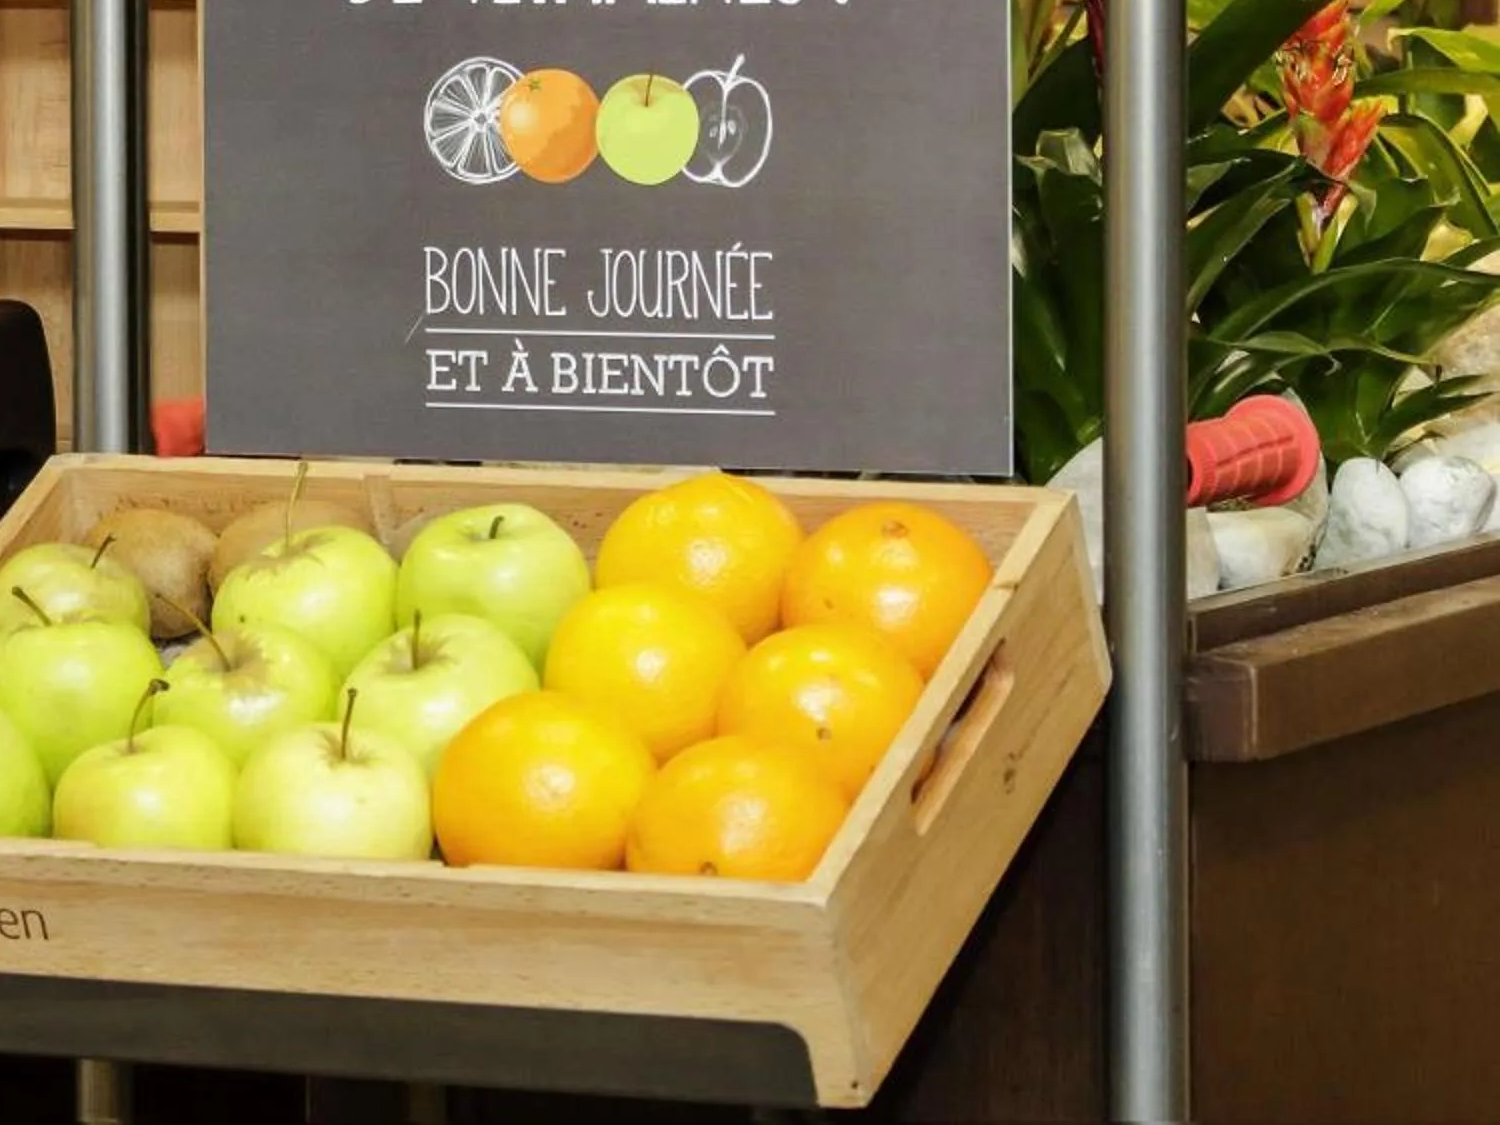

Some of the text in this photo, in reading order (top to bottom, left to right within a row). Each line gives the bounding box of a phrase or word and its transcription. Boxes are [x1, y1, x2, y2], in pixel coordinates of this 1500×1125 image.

[423, 241, 774, 320] BONNE JOURNÉE
[425, 337, 775, 398] ET À BIENTÔT
